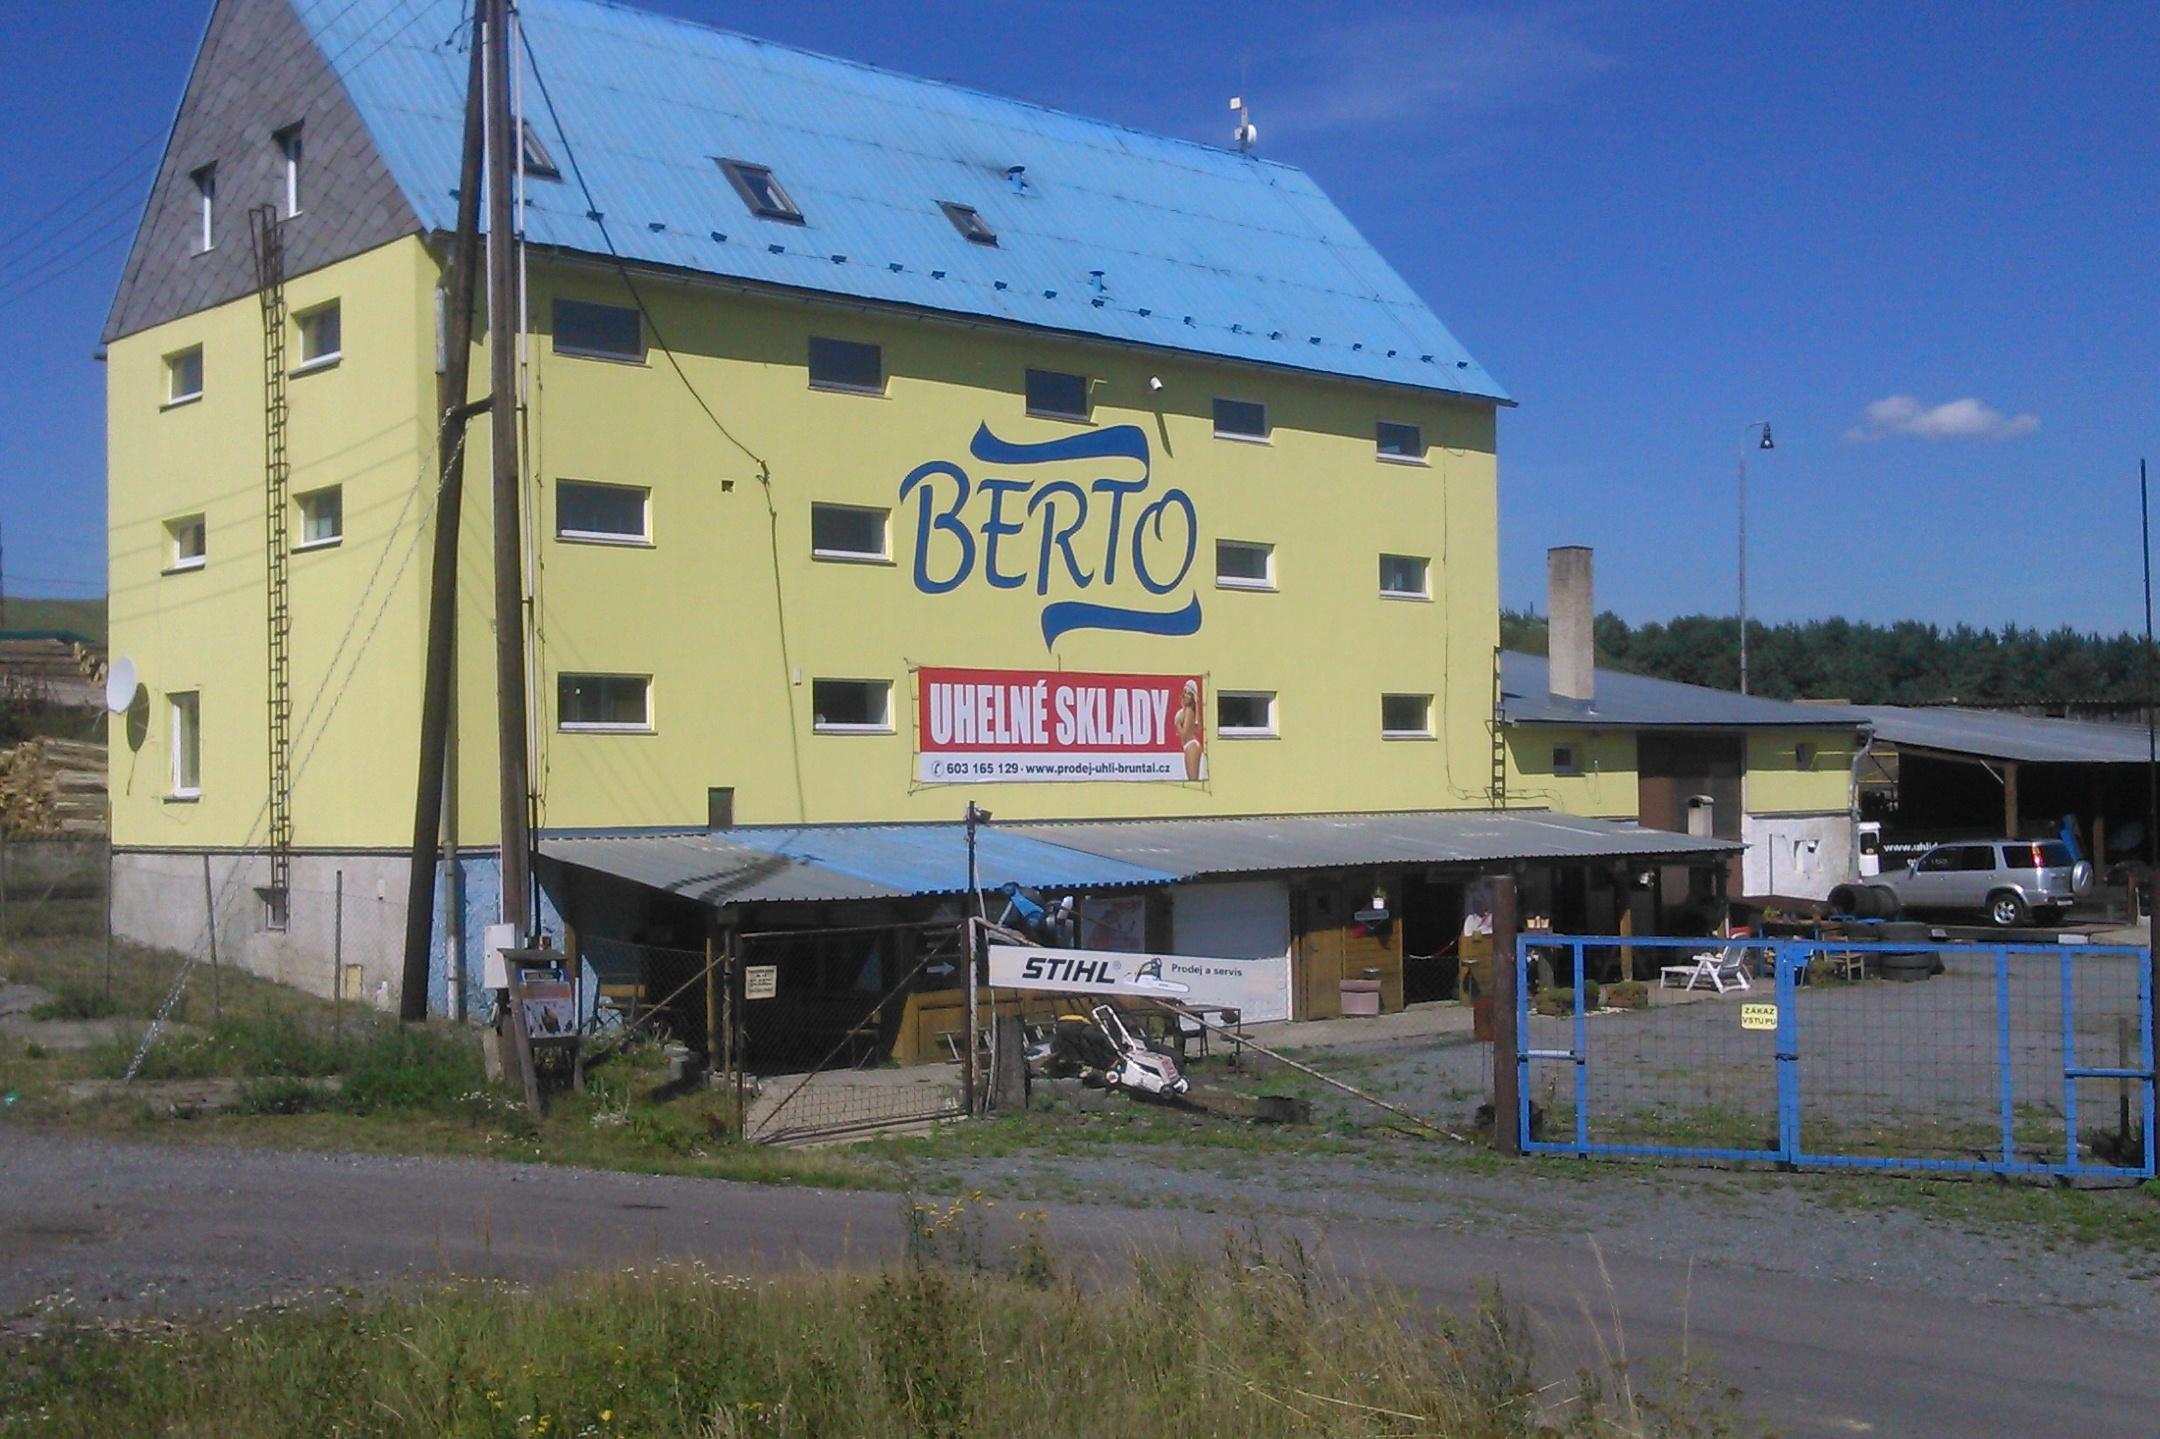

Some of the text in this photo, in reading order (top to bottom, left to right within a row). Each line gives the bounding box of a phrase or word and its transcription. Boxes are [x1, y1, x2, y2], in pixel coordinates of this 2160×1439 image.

[900, 420, 1198, 595] BERTO
[930, 679, 1169, 746] UHELNÉ SKLADY
[946, 762, 1171, 776] 603 165 129 www.prodej-uhli-bruntal.cz
[1022, 957, 1116, 985] STIHL
[1171, 963, 1243, 977] Prodej a servis
